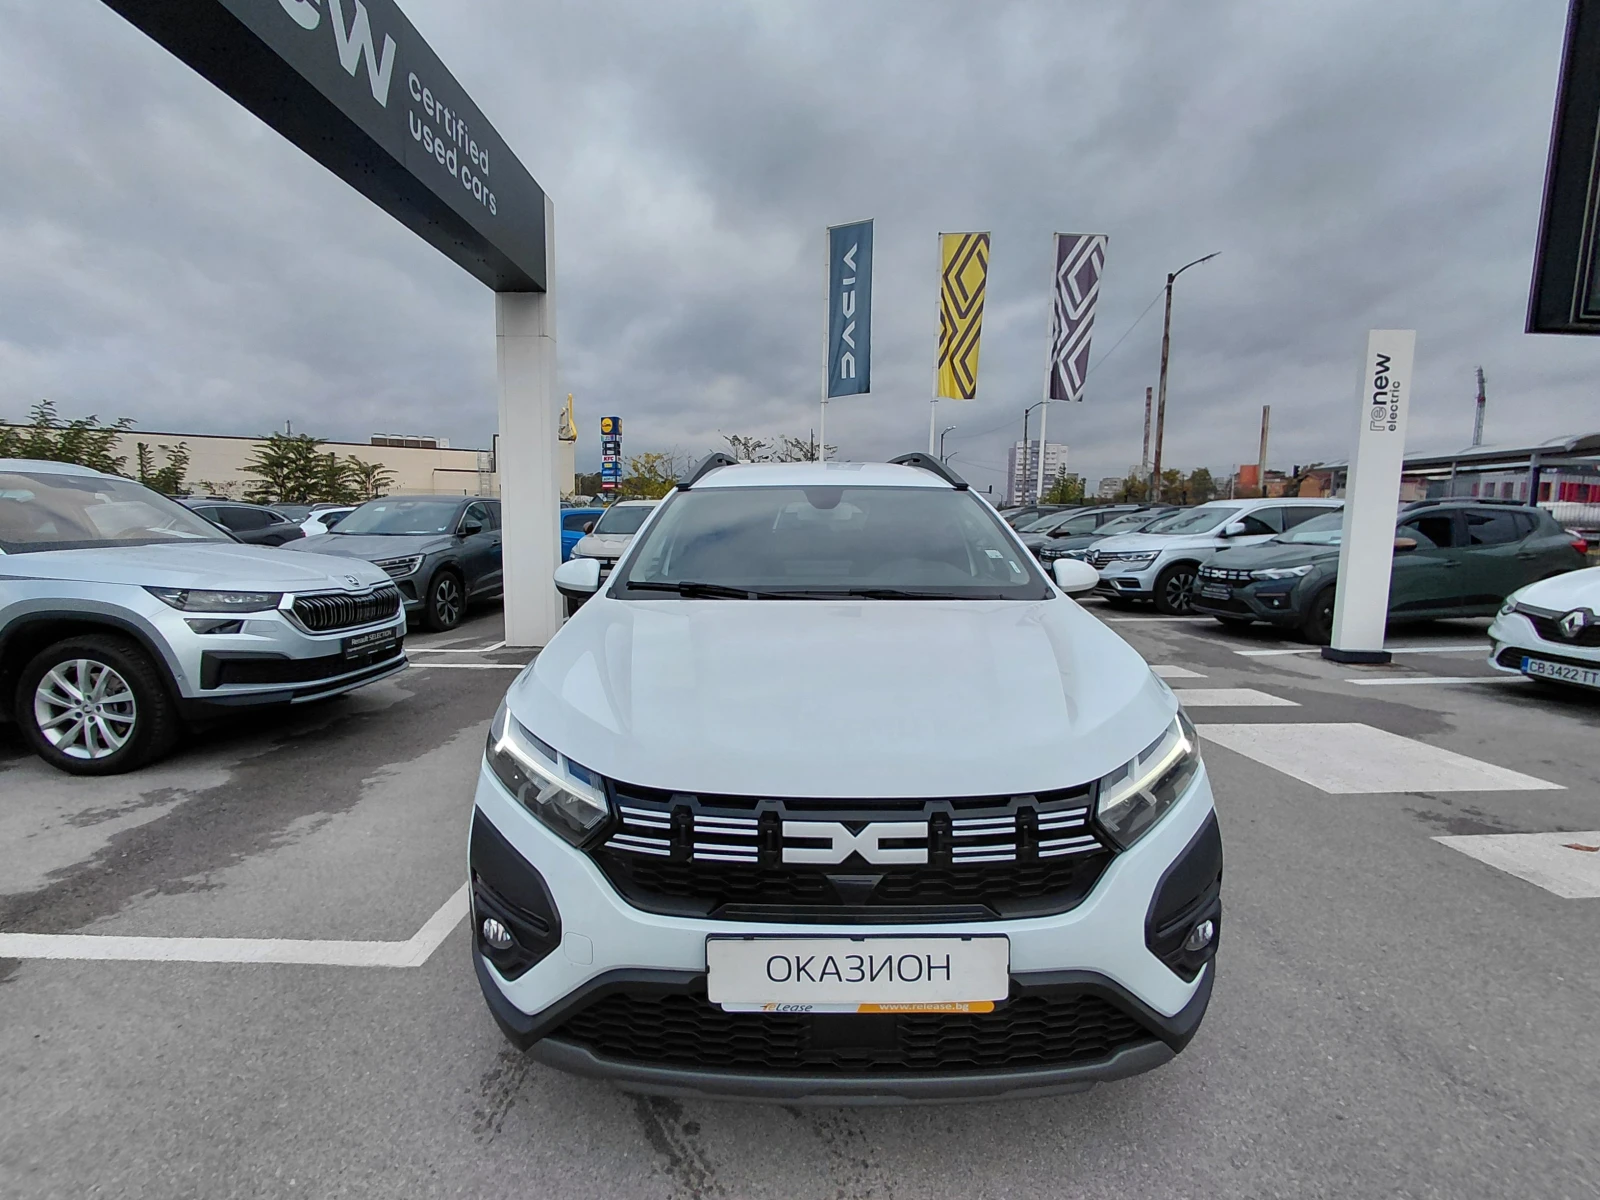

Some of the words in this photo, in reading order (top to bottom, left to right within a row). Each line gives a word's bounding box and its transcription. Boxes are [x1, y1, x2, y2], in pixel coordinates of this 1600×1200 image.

[408, 71, 489, 177] certified
[408, 109, 458, 180] used
[461, 165, 498, 216] cars
[841, 242, 858, 380] DACIA
[1370, 352, 1391, 432] renew
[1387, 380, 1401, 432] electric
[351, 635, 369, 646] Renault
[368, 630, 393, 640] SELECTION
[1529, 660, 1546, 674] CB
[1547, 664, 1580, 681] 3422
[766, 953, 951, 984] ОКАЗИОН
[878, 1001, 970, 1013] www.release.bg
